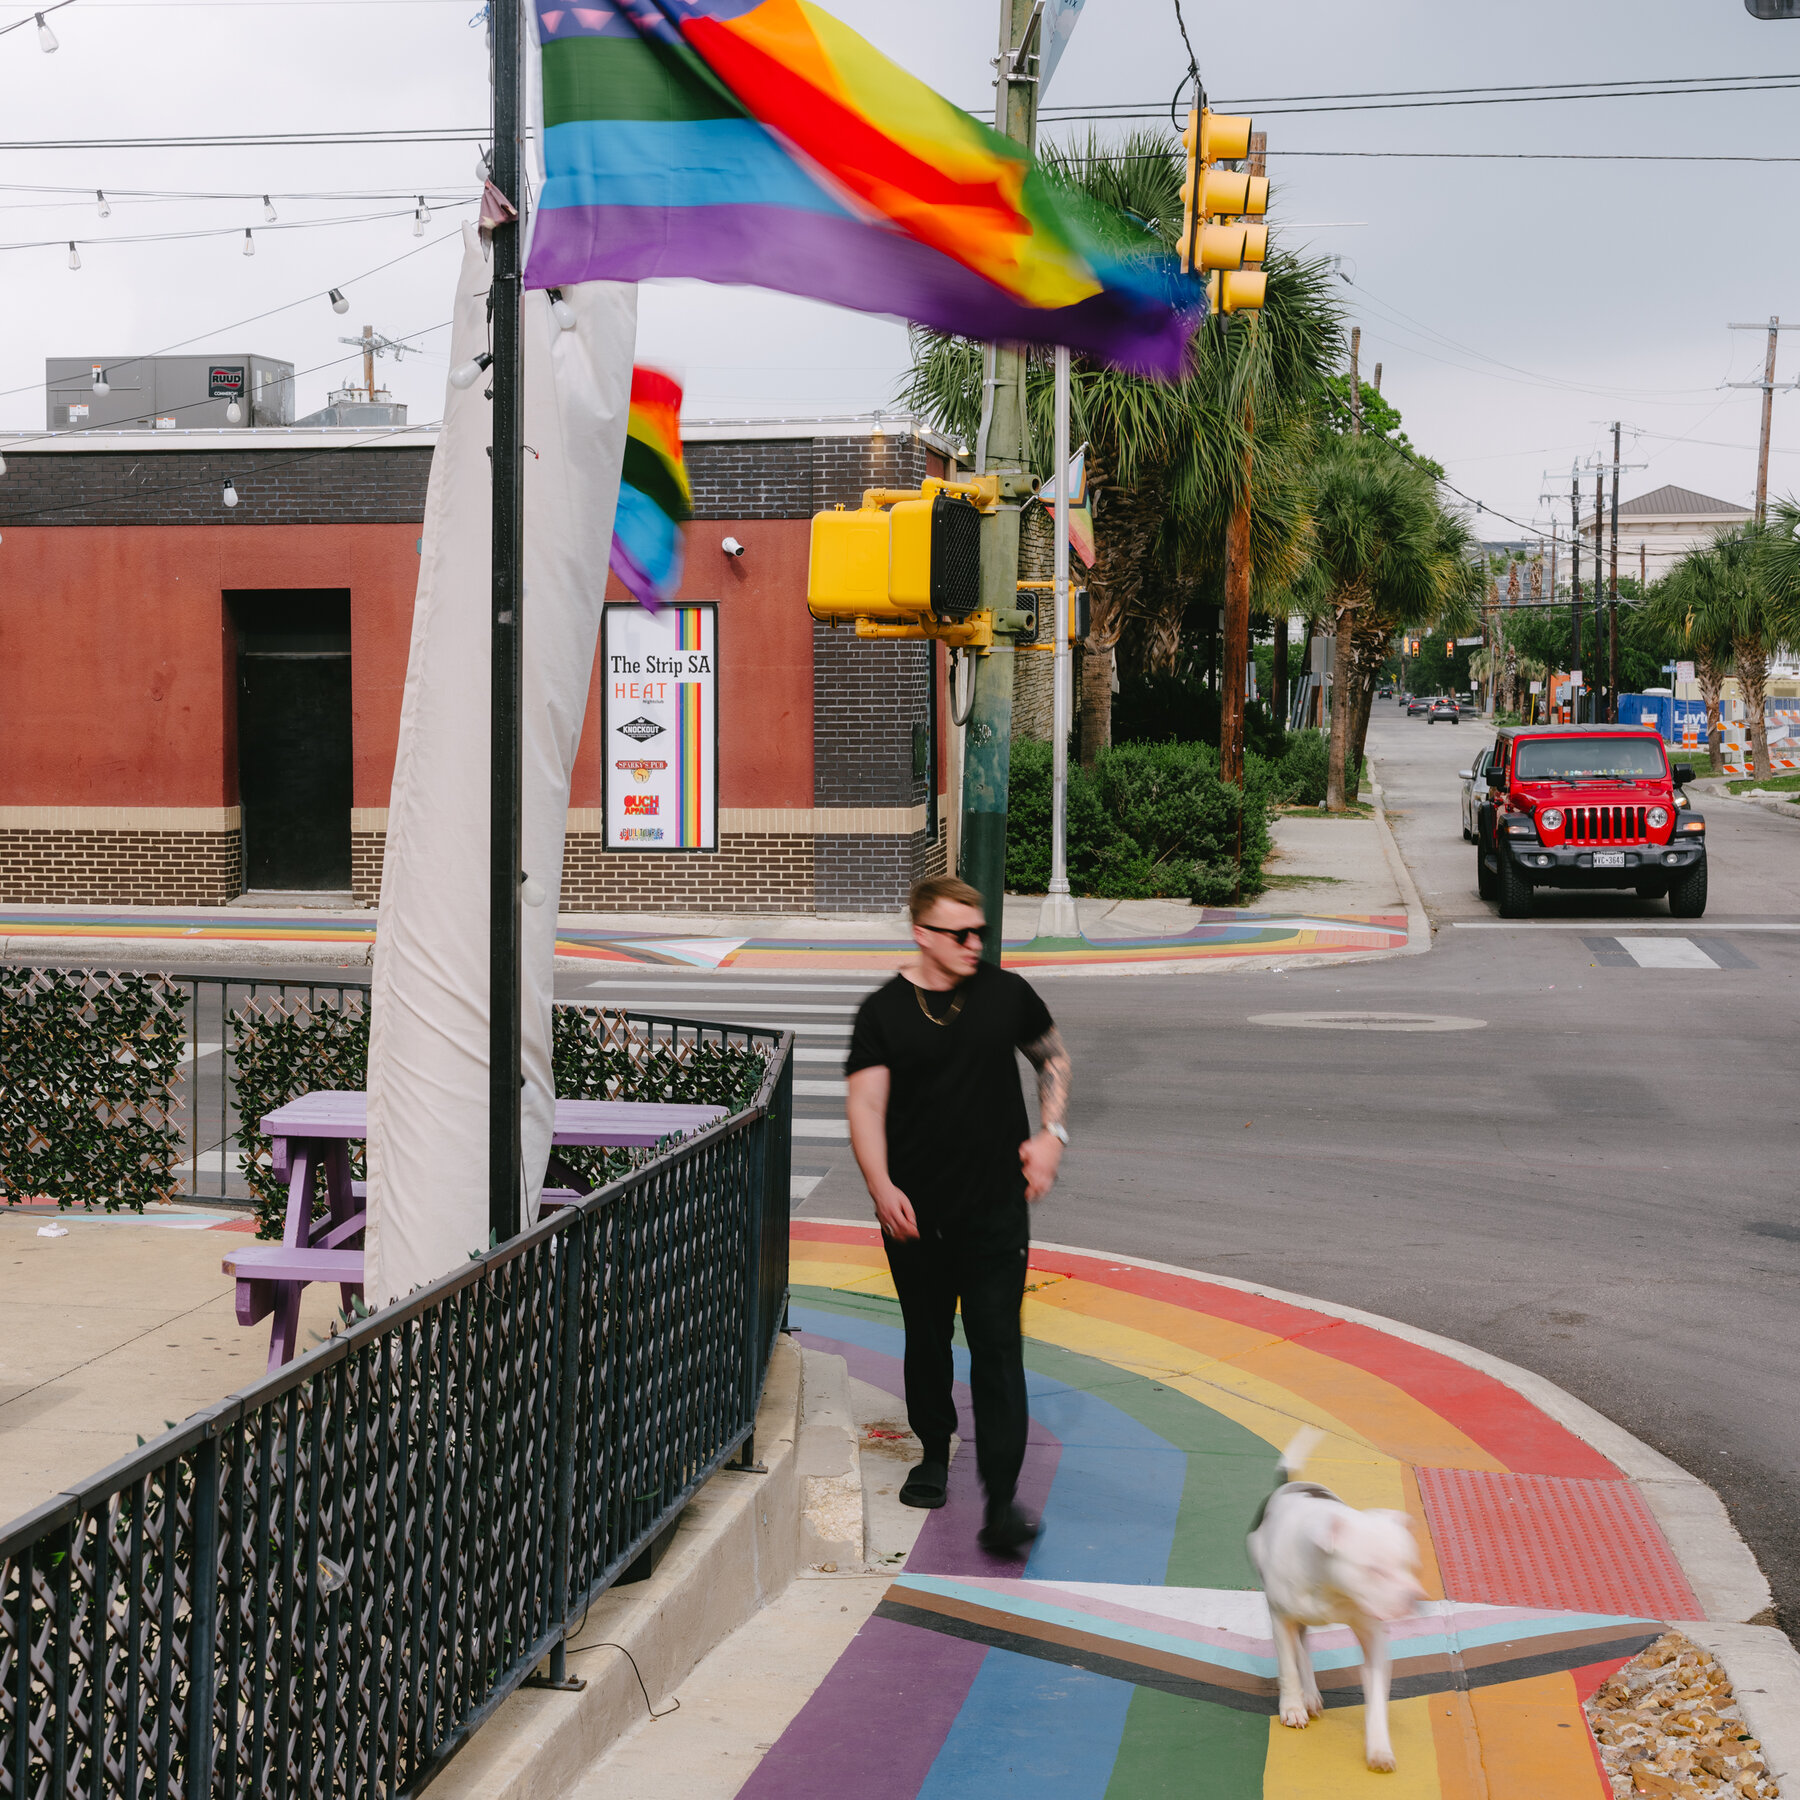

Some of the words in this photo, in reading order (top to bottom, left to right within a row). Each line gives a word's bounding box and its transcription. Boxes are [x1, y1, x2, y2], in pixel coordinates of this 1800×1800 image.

[212, 375, 241, 383] RUUD
[611, 655, 640, 673] The
[646, 655, 683, 678] Strip
[688, 655, 711, 673] SA
[615, 682, 668, 699] HEAT
[622, 725, 660, 734] KNOCKOUT
[624, 795, 659, 808] OUCH
[624, 807, 659, 816] APPAREL
